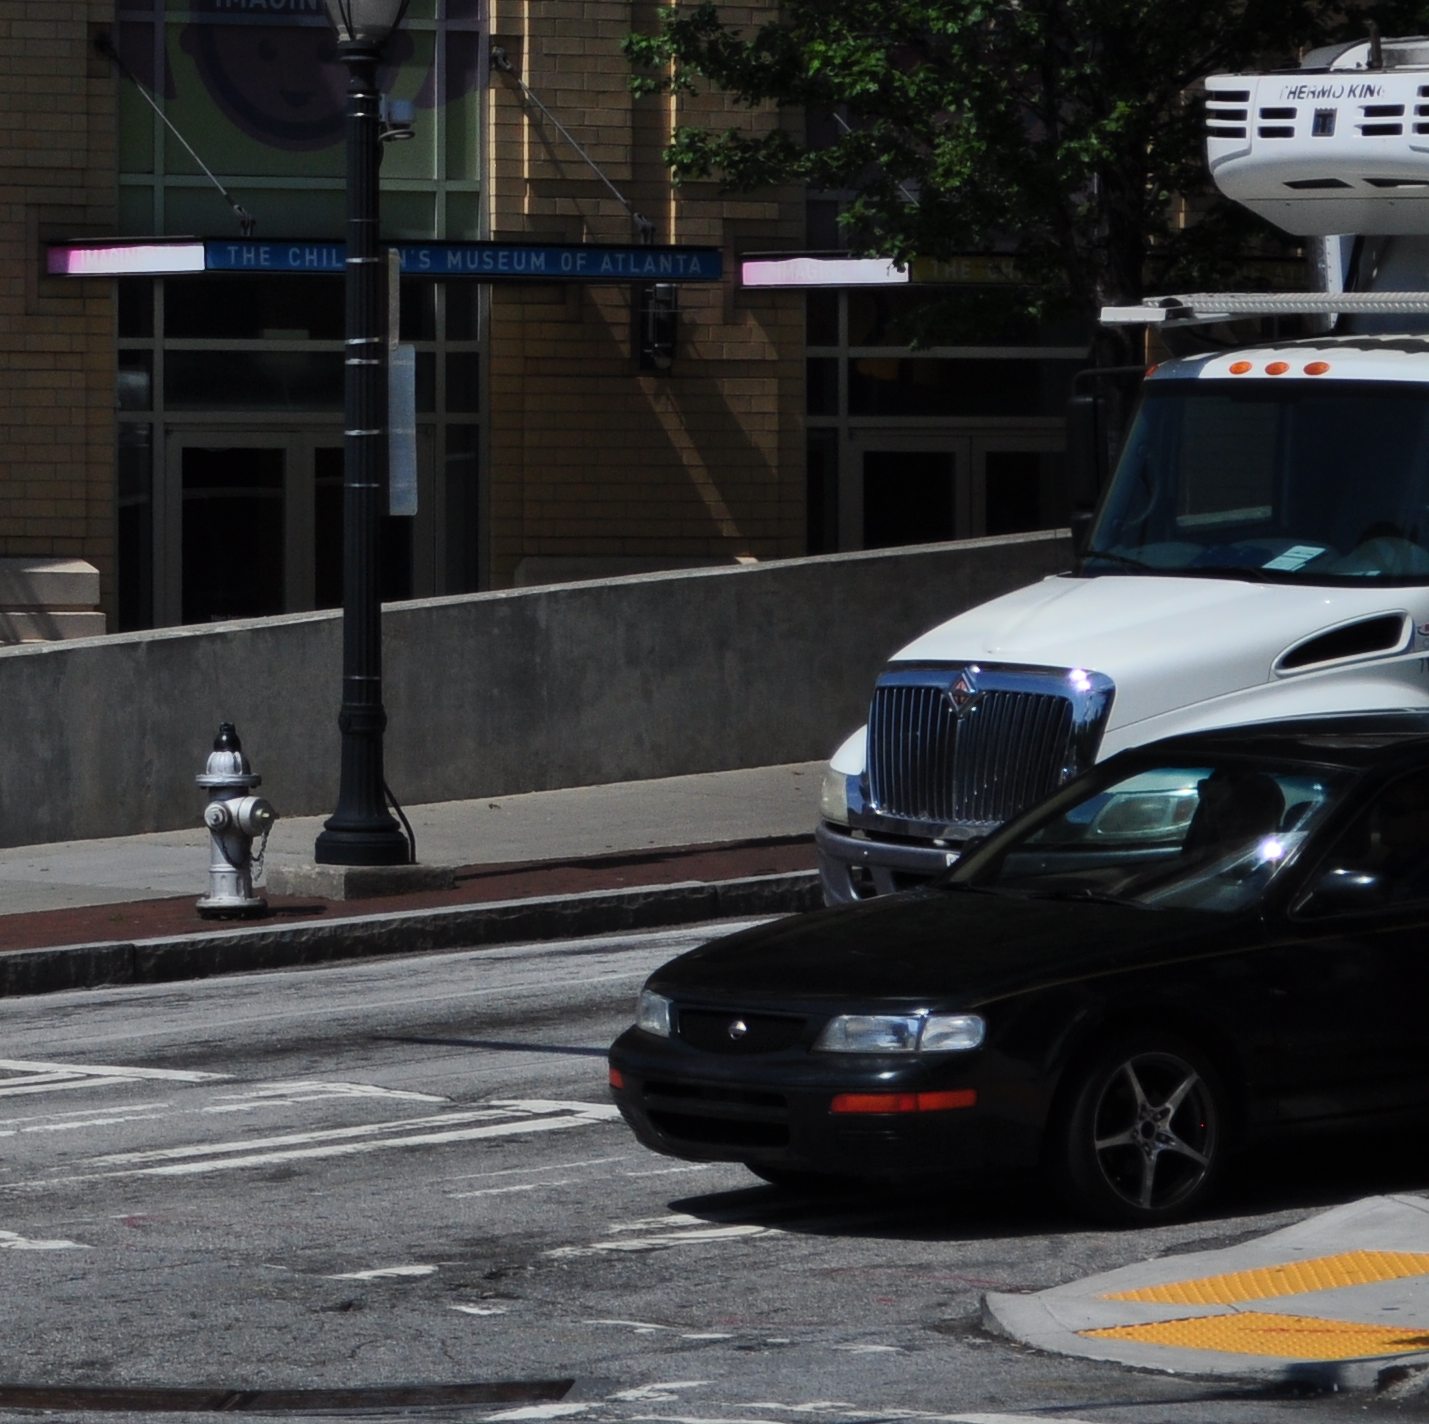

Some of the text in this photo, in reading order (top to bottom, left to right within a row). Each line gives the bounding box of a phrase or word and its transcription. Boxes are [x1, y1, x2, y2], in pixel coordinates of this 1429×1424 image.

[226, 245, 702, 274] THE CHILN'S MUSEUM OF ATLANTA
